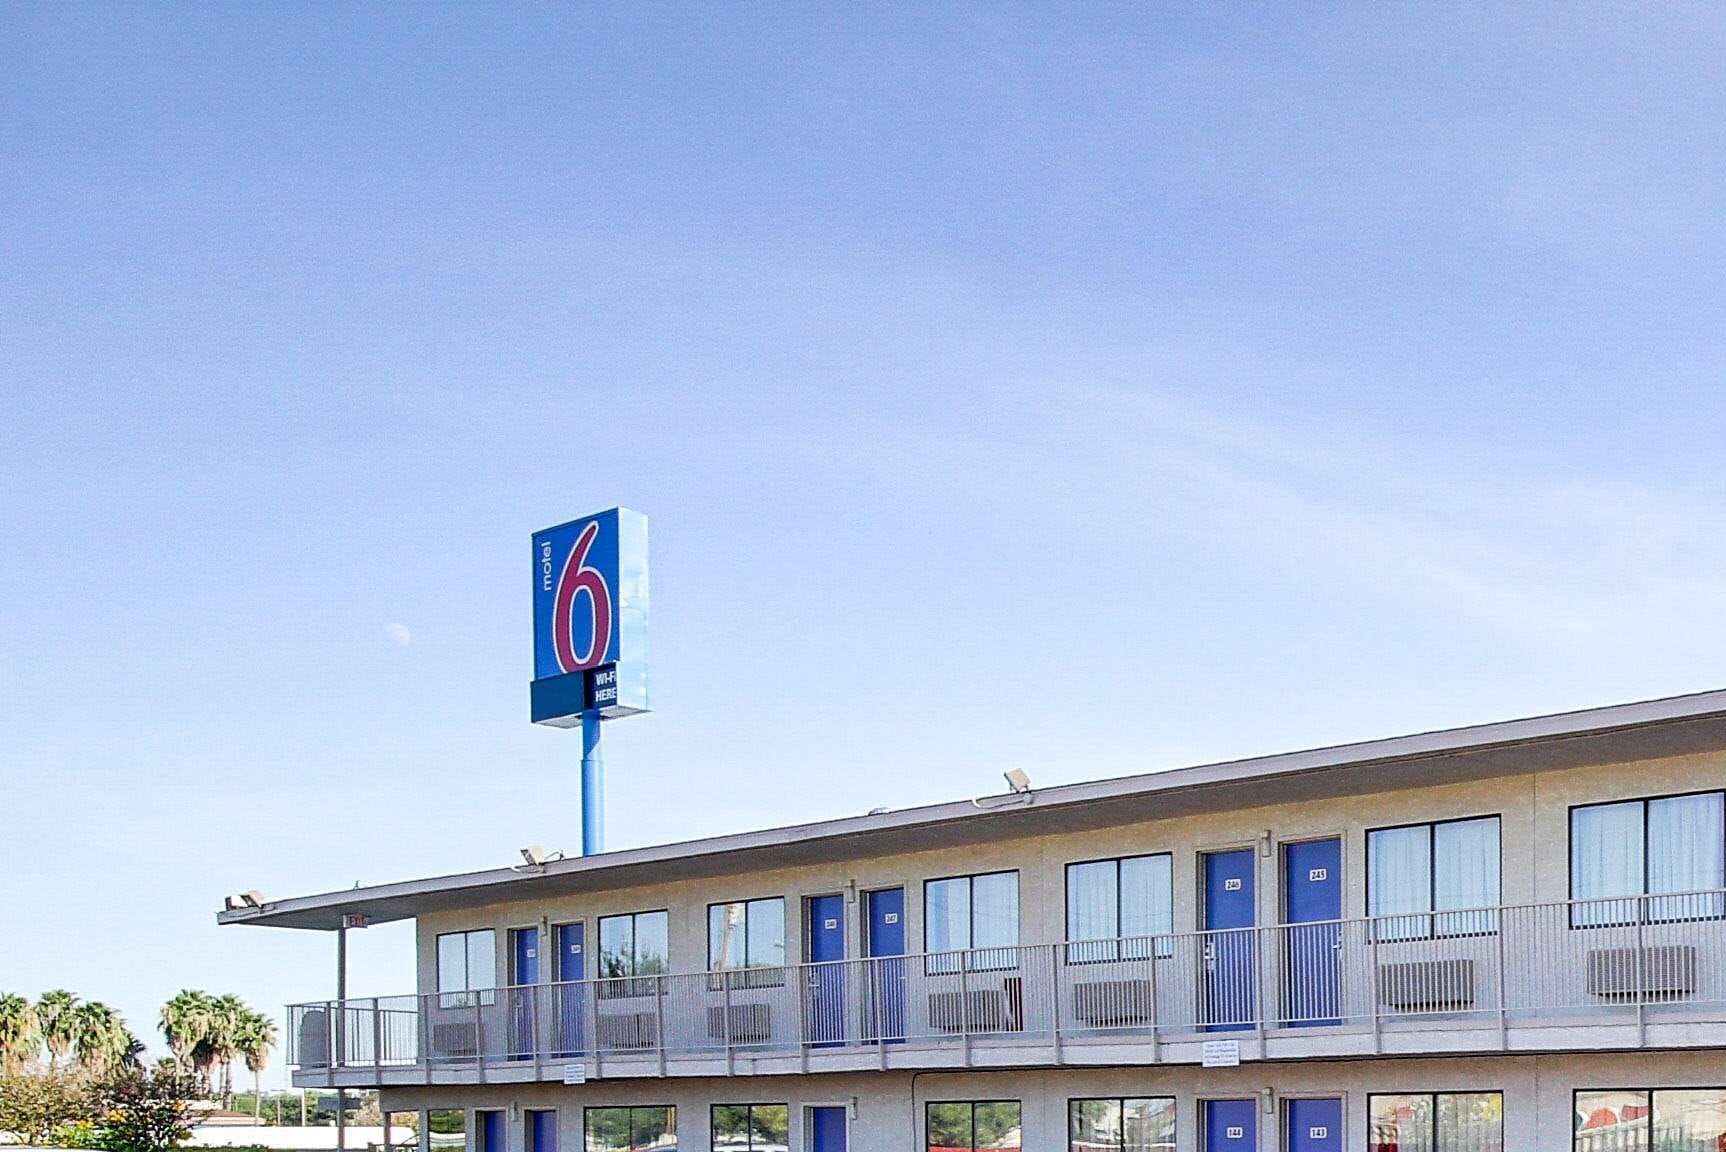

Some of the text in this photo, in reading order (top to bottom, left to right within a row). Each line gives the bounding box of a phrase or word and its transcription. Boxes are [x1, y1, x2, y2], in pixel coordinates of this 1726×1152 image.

[541, 541, 552, 591] motel
[553, 520, 612, 674] 6
[596, 687, 616, 702] HERE
[1311, 870, 1325, 880] 245
[1227, 880, 1239, 889] 246
[1312, 1128, 1325, 1137] 143
